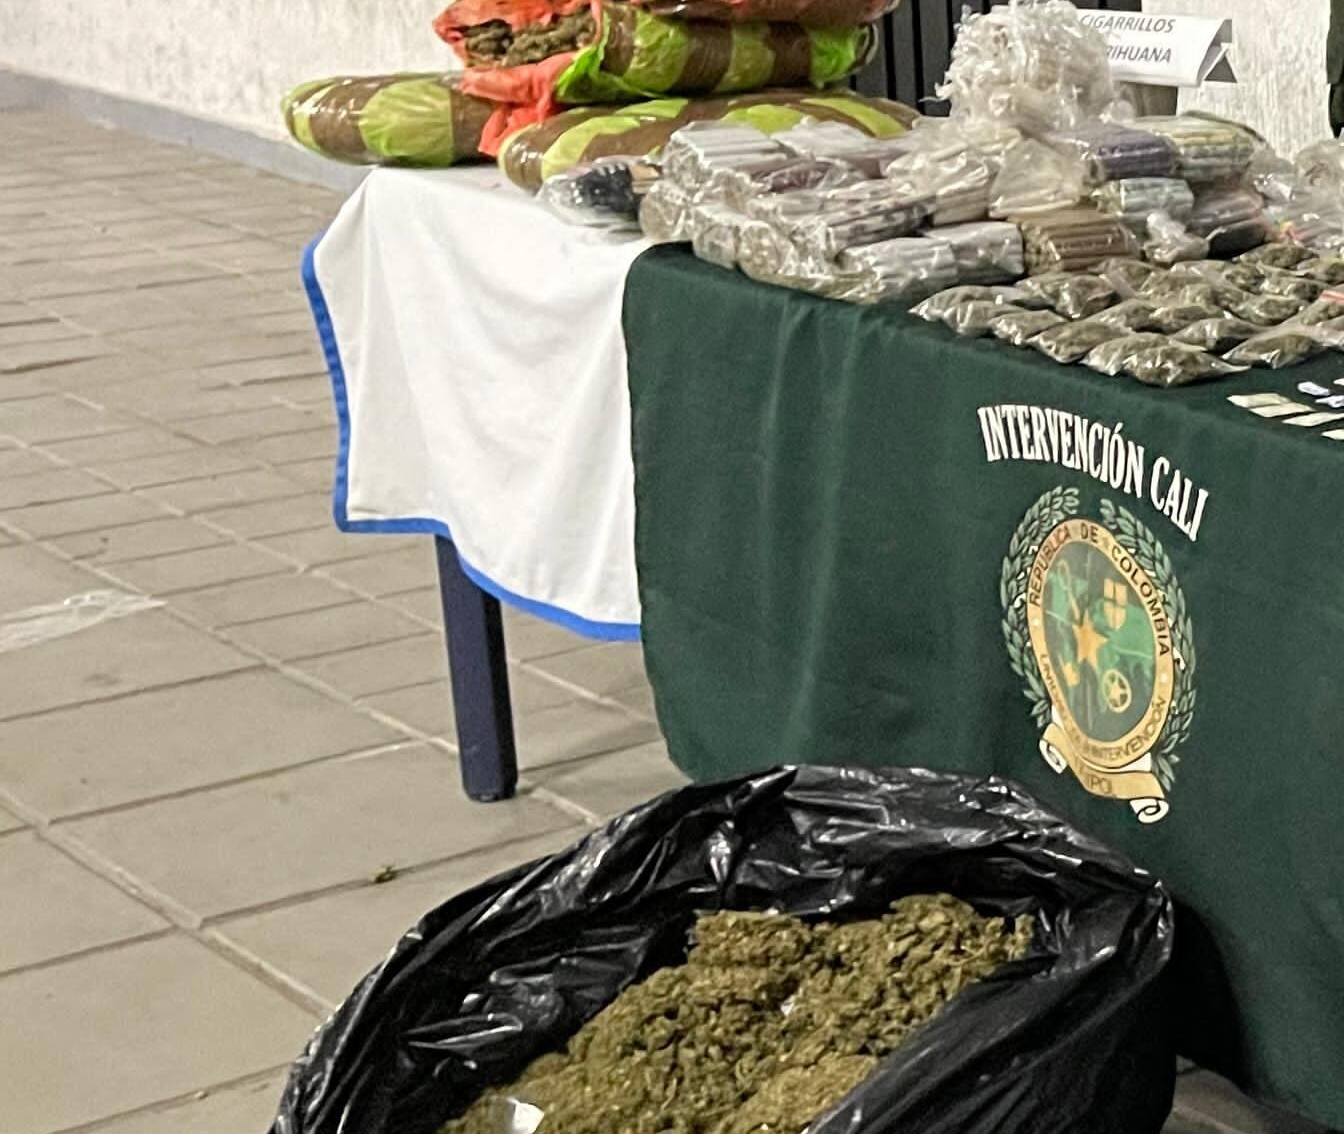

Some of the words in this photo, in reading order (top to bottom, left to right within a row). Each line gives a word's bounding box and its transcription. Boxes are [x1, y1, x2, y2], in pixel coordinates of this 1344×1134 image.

[977, 403, 1145, 500] INTERVENCIÓN
[1149, 456, 1210, 543] CALI
[1079, 521, 1100, 544] DE
[1111, 545, 1170, 656] COLOMBIA
